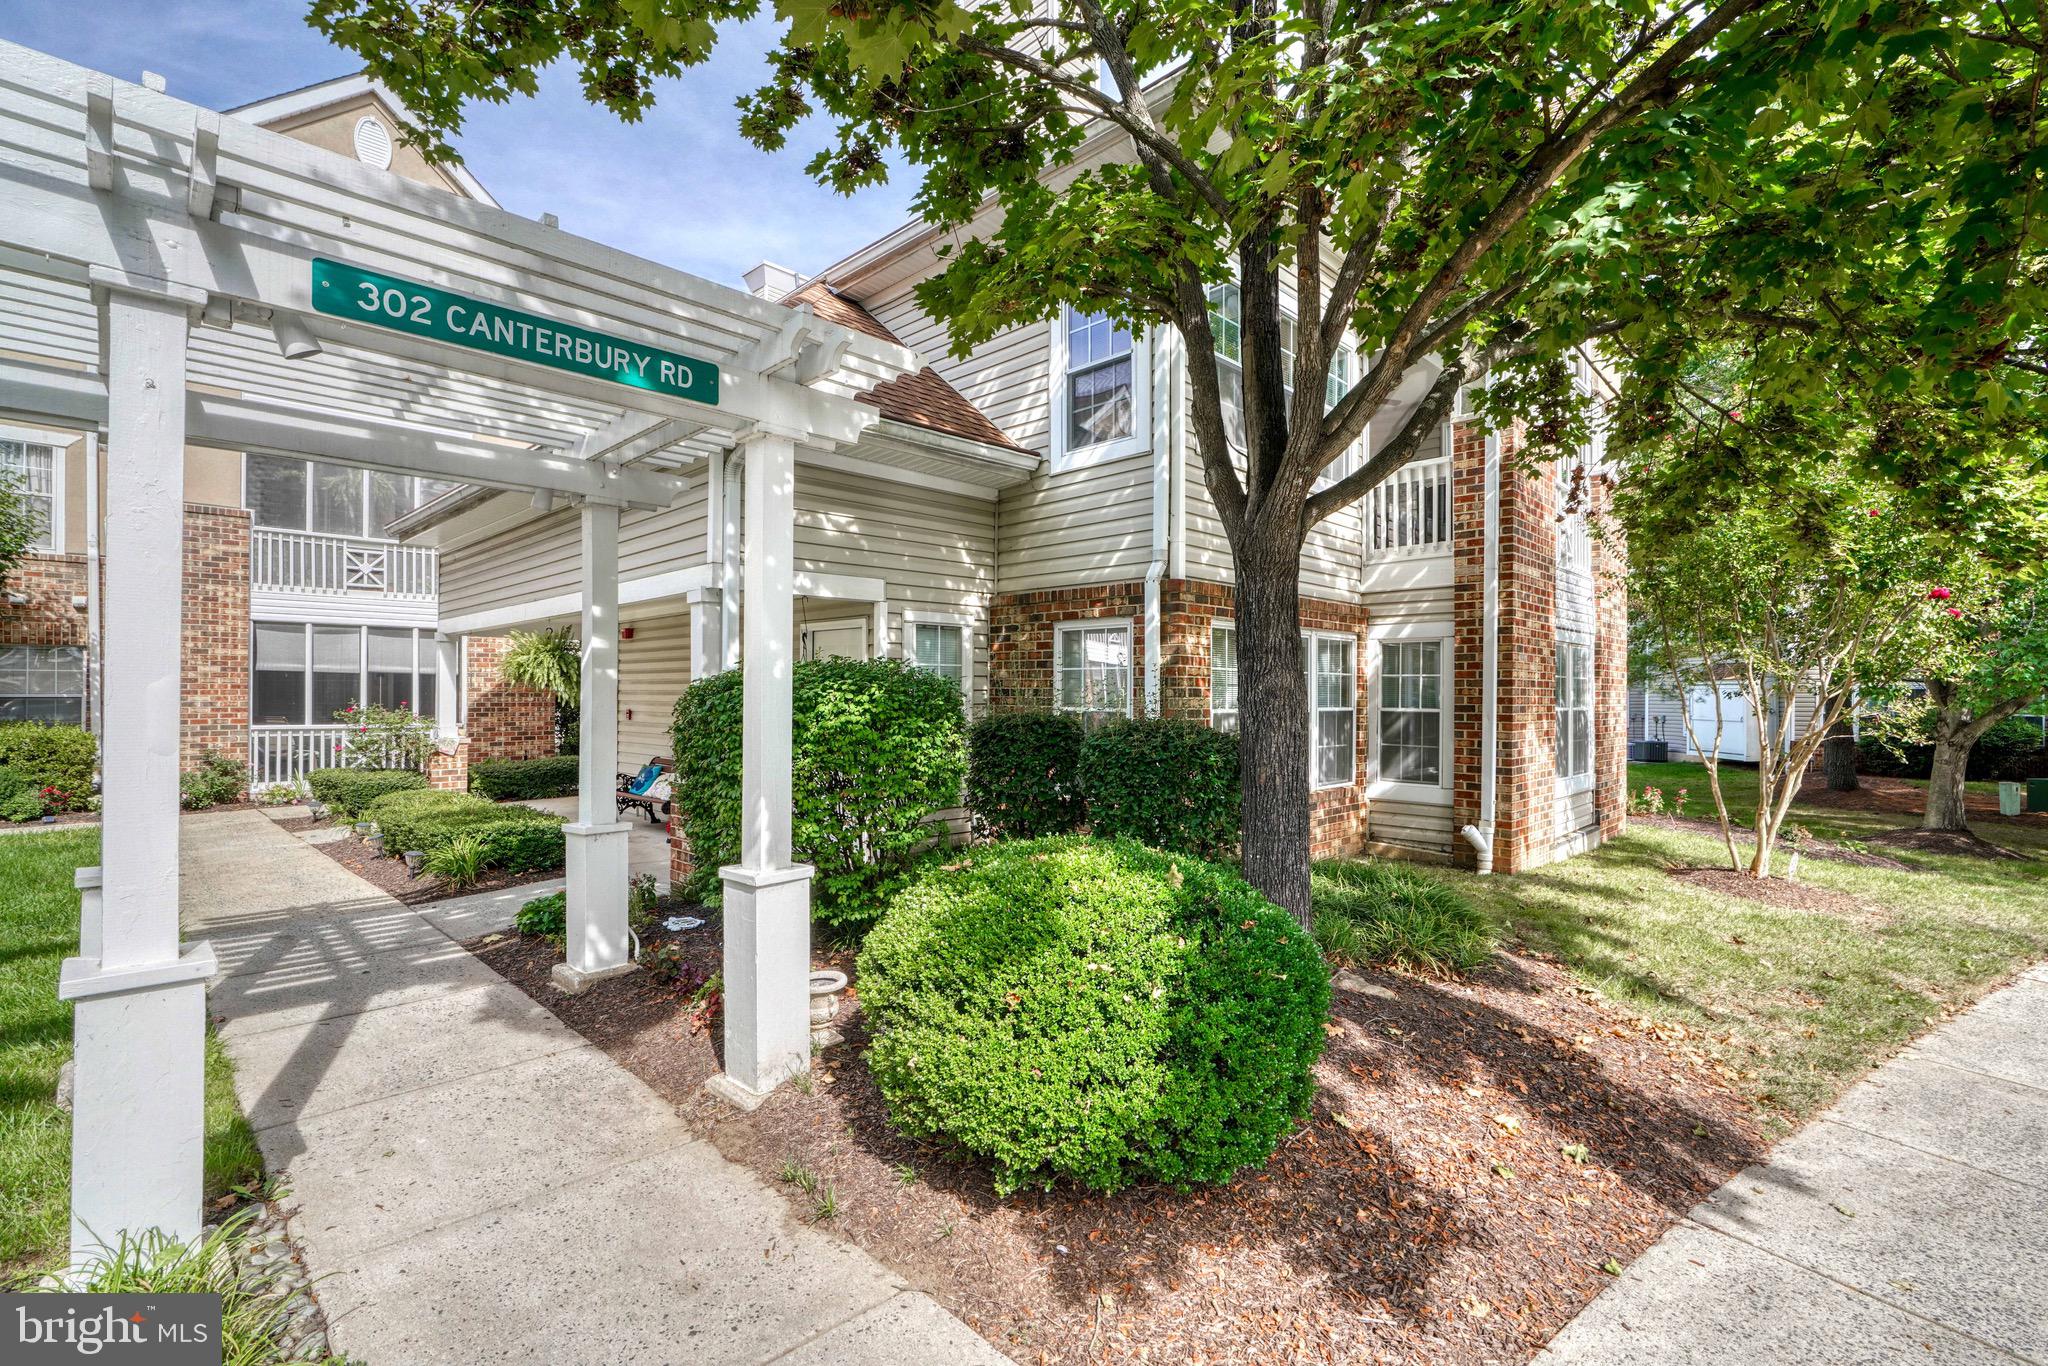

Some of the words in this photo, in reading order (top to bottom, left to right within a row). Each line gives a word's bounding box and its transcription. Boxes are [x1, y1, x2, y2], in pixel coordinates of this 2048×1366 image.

[357, 282, 432, 325] 302
[446, 305, 651, 377] CANTERBURY
[660, 360, 693, 389] RD
